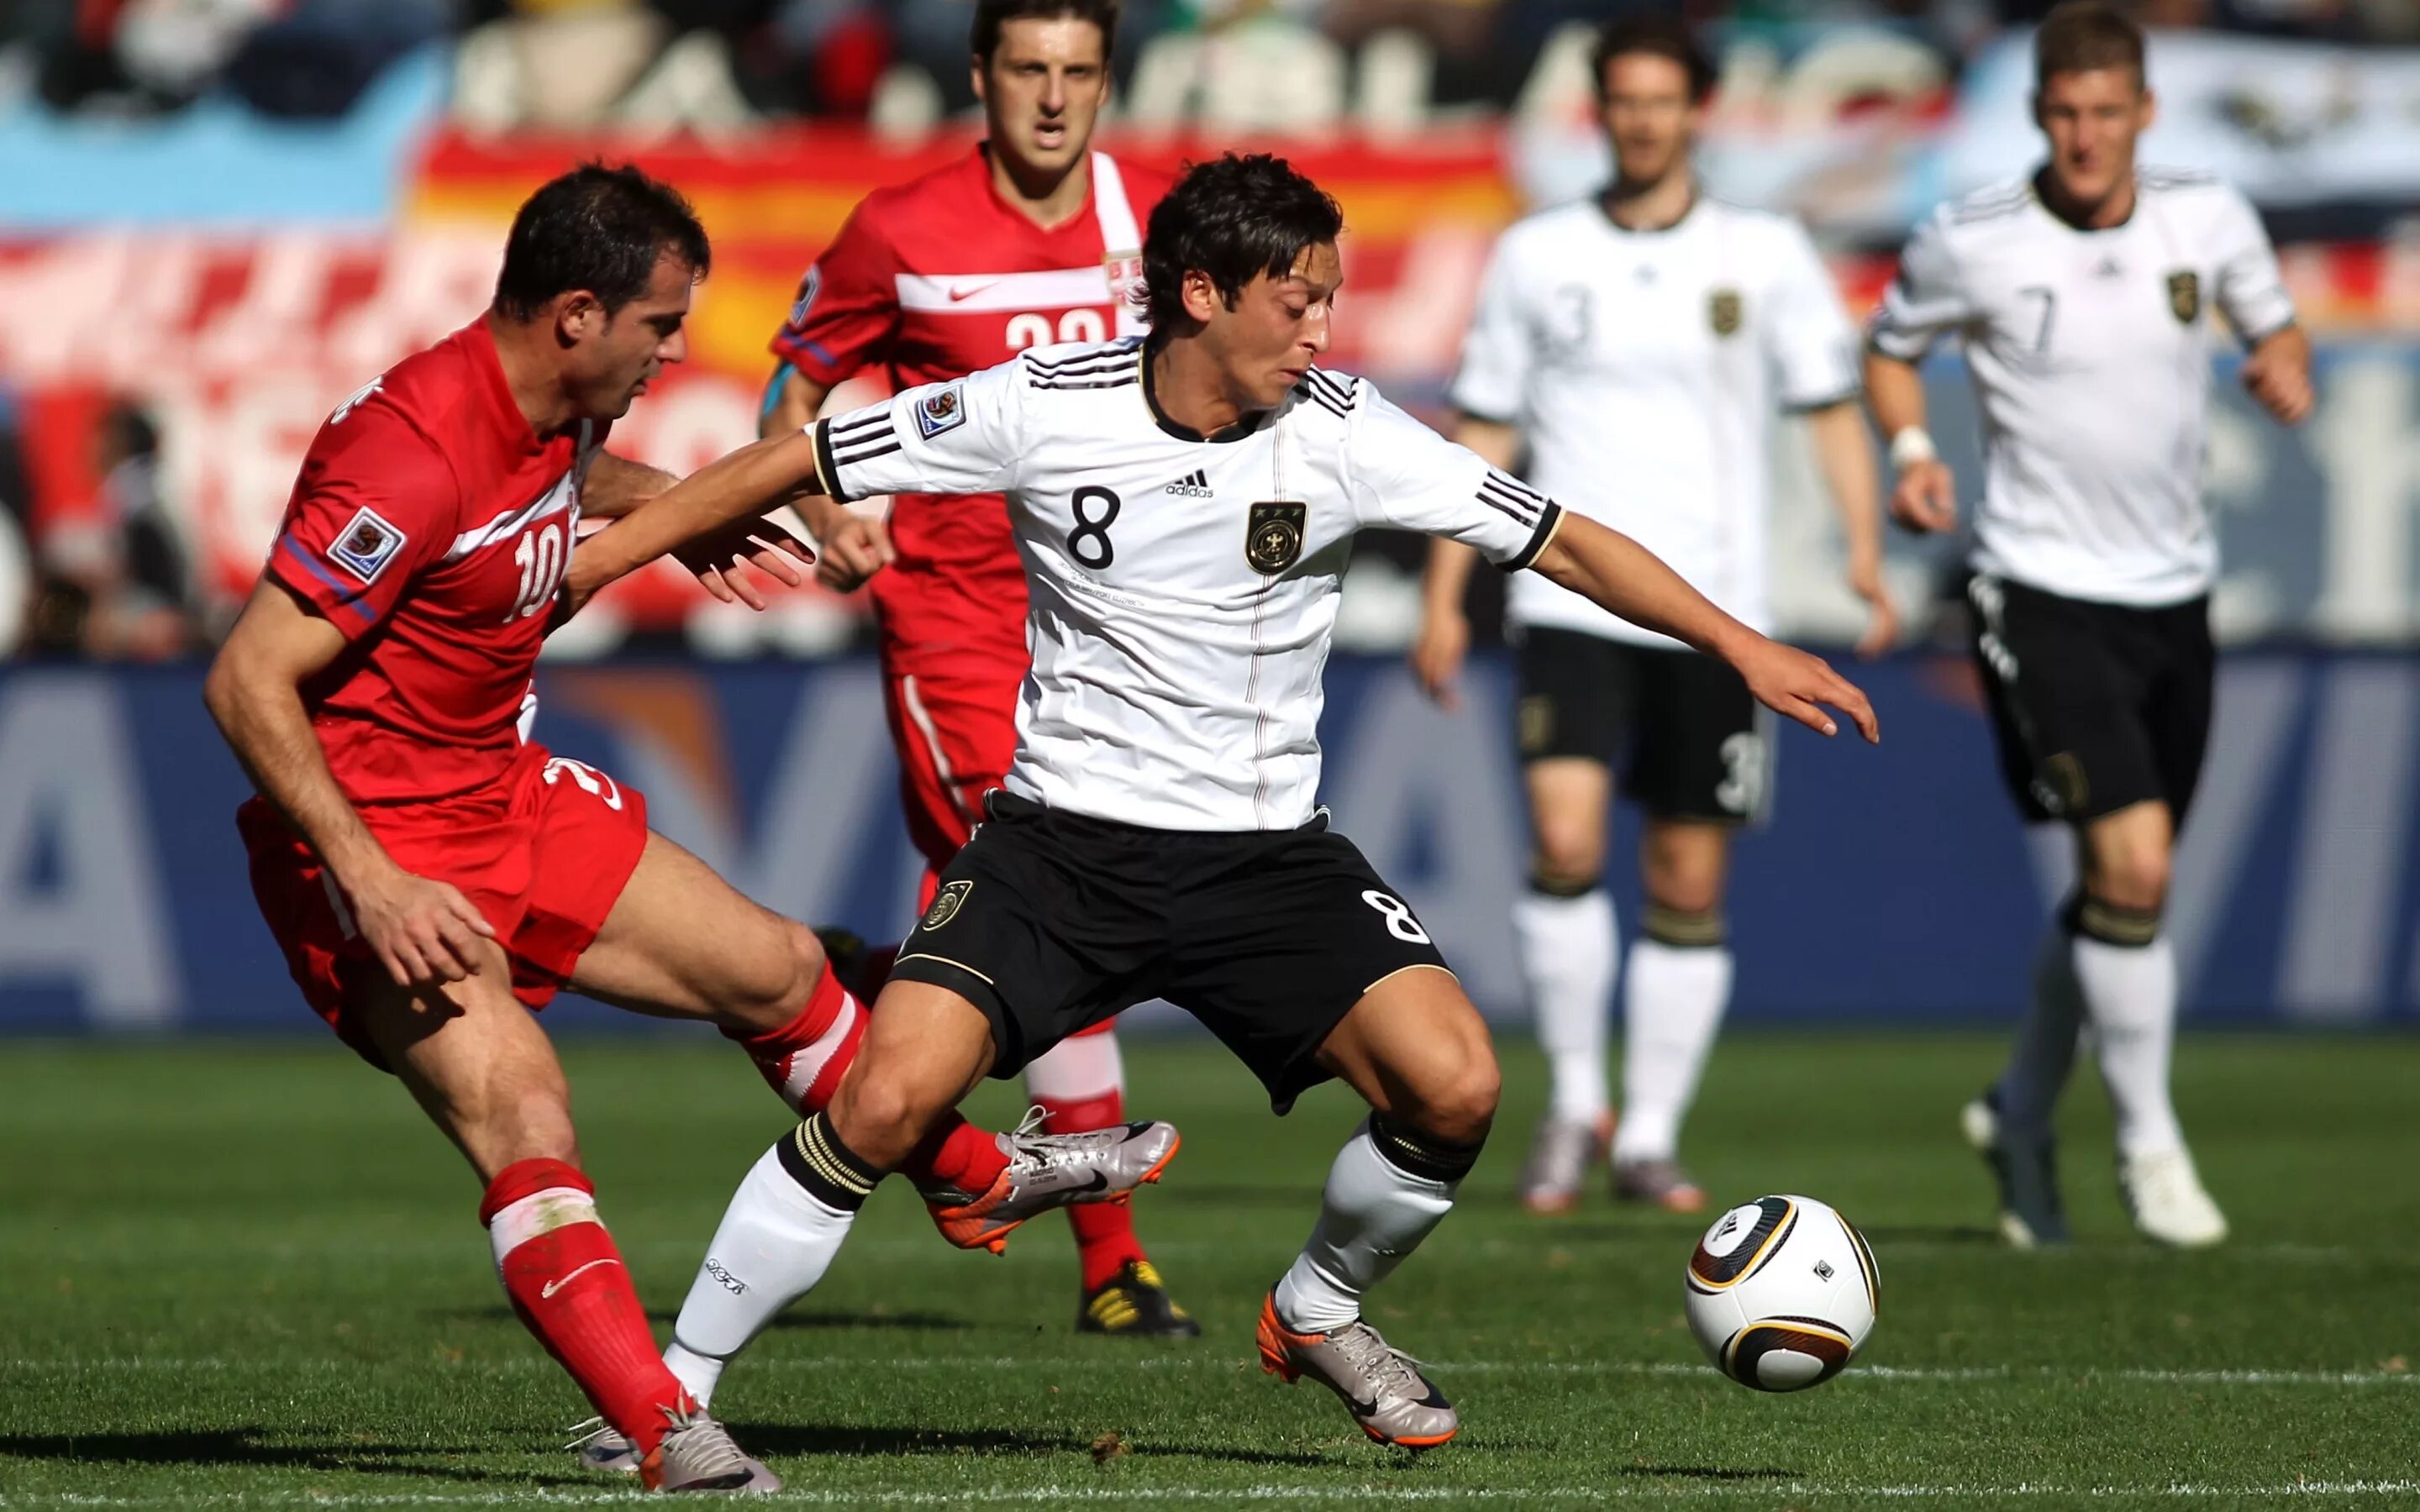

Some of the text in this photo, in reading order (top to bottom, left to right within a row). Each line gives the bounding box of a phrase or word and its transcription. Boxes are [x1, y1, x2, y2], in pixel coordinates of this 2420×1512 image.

[2016, 286, 2055, 357] 7
[1066, 486, 1121, 570] 8
[1165, 484, 1213, 498] adidas
[502, 523, 560, 622] 10
[1715, 730, 1765, 812] 3
[1361, 890, 1431, 945] 8
